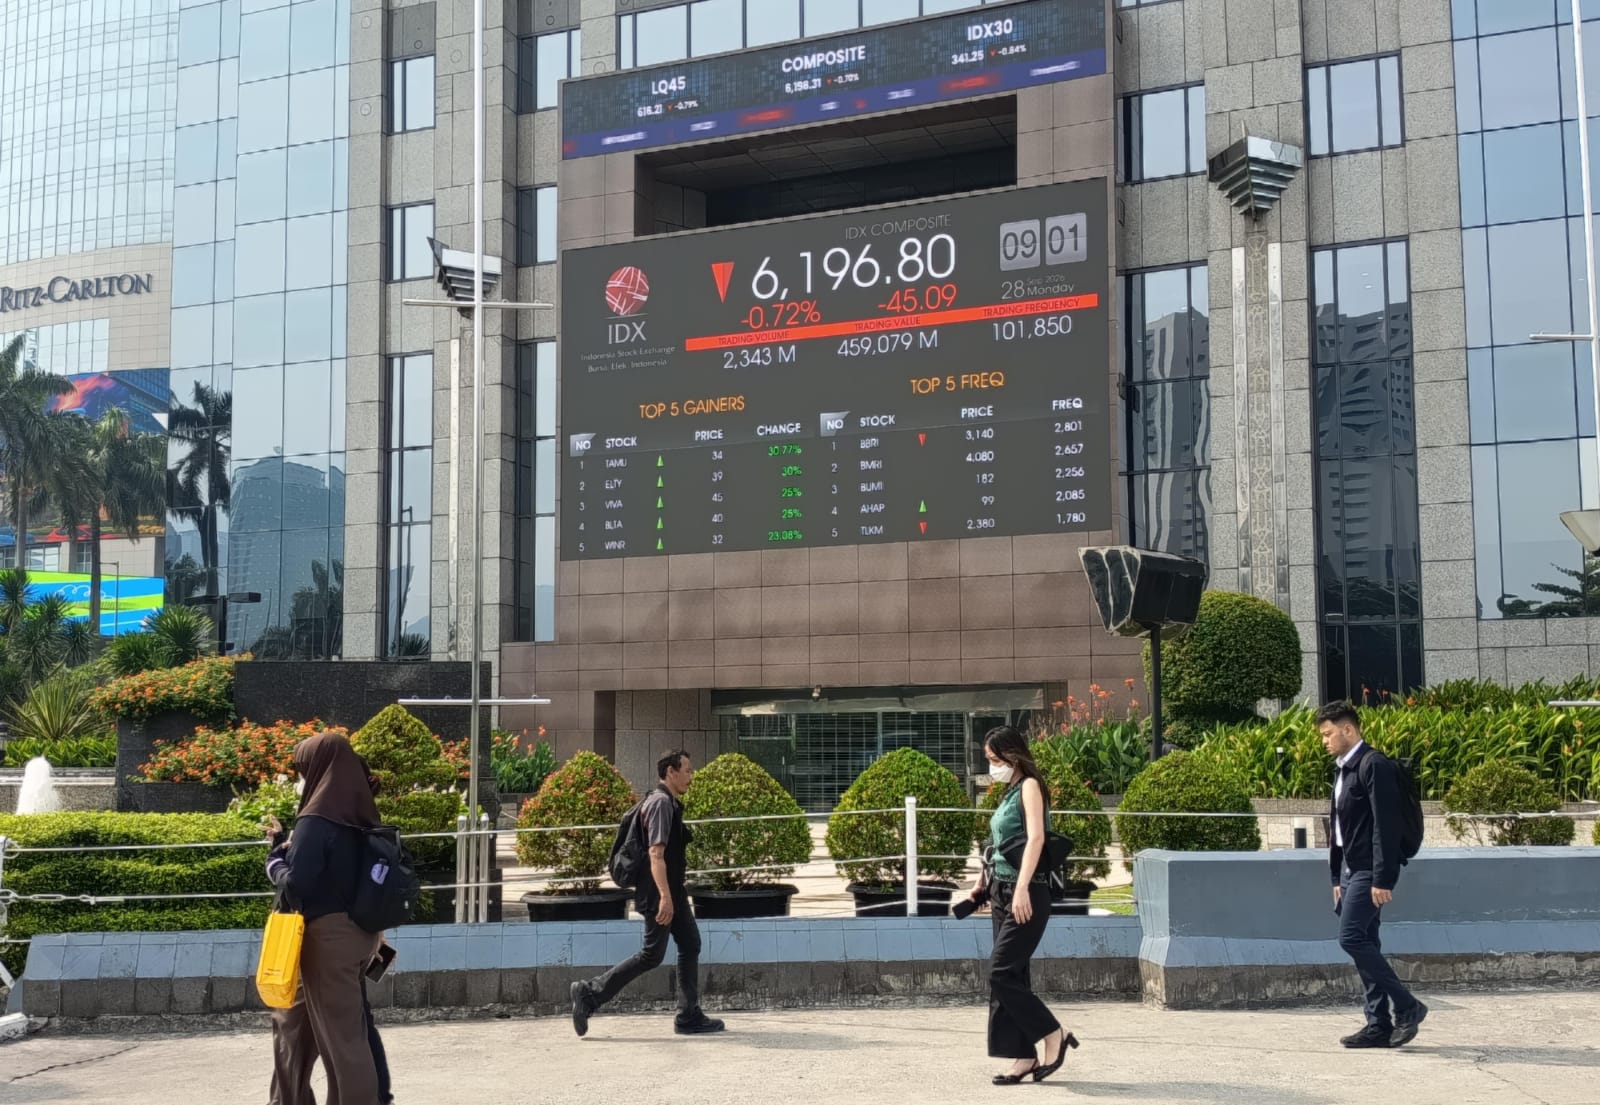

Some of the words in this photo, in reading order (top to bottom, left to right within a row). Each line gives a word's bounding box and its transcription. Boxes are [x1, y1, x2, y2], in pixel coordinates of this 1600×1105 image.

[967, 18, 1013, 41] IDX30
[782, 45, 866, 73] COMPOSITE
[951, 50, 984, 65] 341.25
[651, 76, 686, 95] LQ45
[845, 226, 868, 240] IDX
[870, 214, 952, 236] COMPOSITE
[1002, 229, 1037, 261] 09
[1048, 222, 1079, 255] 01
[751, 233, 956, 301] 6,196.80
[878, 283, 957, 313] -45.09
[1001, 280, 1025, 300] 28
[1027, 283, 1074, 296] Monday
[740, 300, 821, 329] -0.72%
[983, 305, 1023, 317] TRADING
[1025, 298, 1081, 313] FREQUENCY
[608, 320, 647, 345] IDX
[855, 320, 892, 332] TRADING
[894, 316, 921, 328] VALUE
[992, 314, 1072, 341] 101,850
[718, 334, 753, 346] TRADING
[755, 330, 791, 342] VOLUME
[837, 332, 913, 357] 459,079
[919, 329, 938, 349] M
[723, 346, 772, 369] 2,343
[778, 344, 796, 363] M
[911, 377, 941, 394] TOP
[945, 375, 956, 392] 5
[961, 371, 1005, 390] FREQ
[639, 403, 666, 419] TOP
[670, 401, 680, 417] 5
[683, 395, 745, 416] GAINERS
[826, 419, 844, 431] NO
[859, 415, 896, 428] STOCK
[961, 405, 994, 419] PRICE
[1052, 397, 1084, 411] FREQ
[575, 440, 592, 451] NO
[605, 436, 638, 449] STOCK
[694, 429, 724, 441] PRICE
[756, 422, 802, 436] CHANGE
[860, 438, 880, 449] BBRI
[965, 427, 994, 441] 3,140
[1054, 420, 1083, 433] 2,801
[712, 450, 724, 461] 34
[767, 444, 803, 457] 30.77%
[831, 462, 839, 473] 2
[860, 460, 883, 471] BMRI
[1055, 443, 1084, 456] 2,657
[579, 480, 586, 491] 2
[605, 479, 623, 489] ELTY
[712, 471, 724, 482] 39
[781, 465, 803, 476] 30%
[831, 483, 839, 494] 3
[860, 481, 884, 493] BUMI
[1055, 466, 1086, 479] 2,256
[579, 501, 586, 511] 3
[605, 500, 624, 510] VIVA
[712, 492, 724, 503] 45
[781, 487, 803, 498] 25%
[831, 505, 839, 516] 4
[860, 503, 886, 514] AHAP
[980, 495, 996, 506] 99
[1055, 489, 1086, 502] 2,085
[578, 522, 586, 531] 4
[712, 513, 724, 524] 40
[781, 508, 803, 519] 25%
[831, 527, 839, 538] 5
[860, 525, 884, 536] TLKM
[1056, 512, 1087, 524] 1,780
[578, 542, 586, 552] 5
[712, 534, 724, 545] 32
